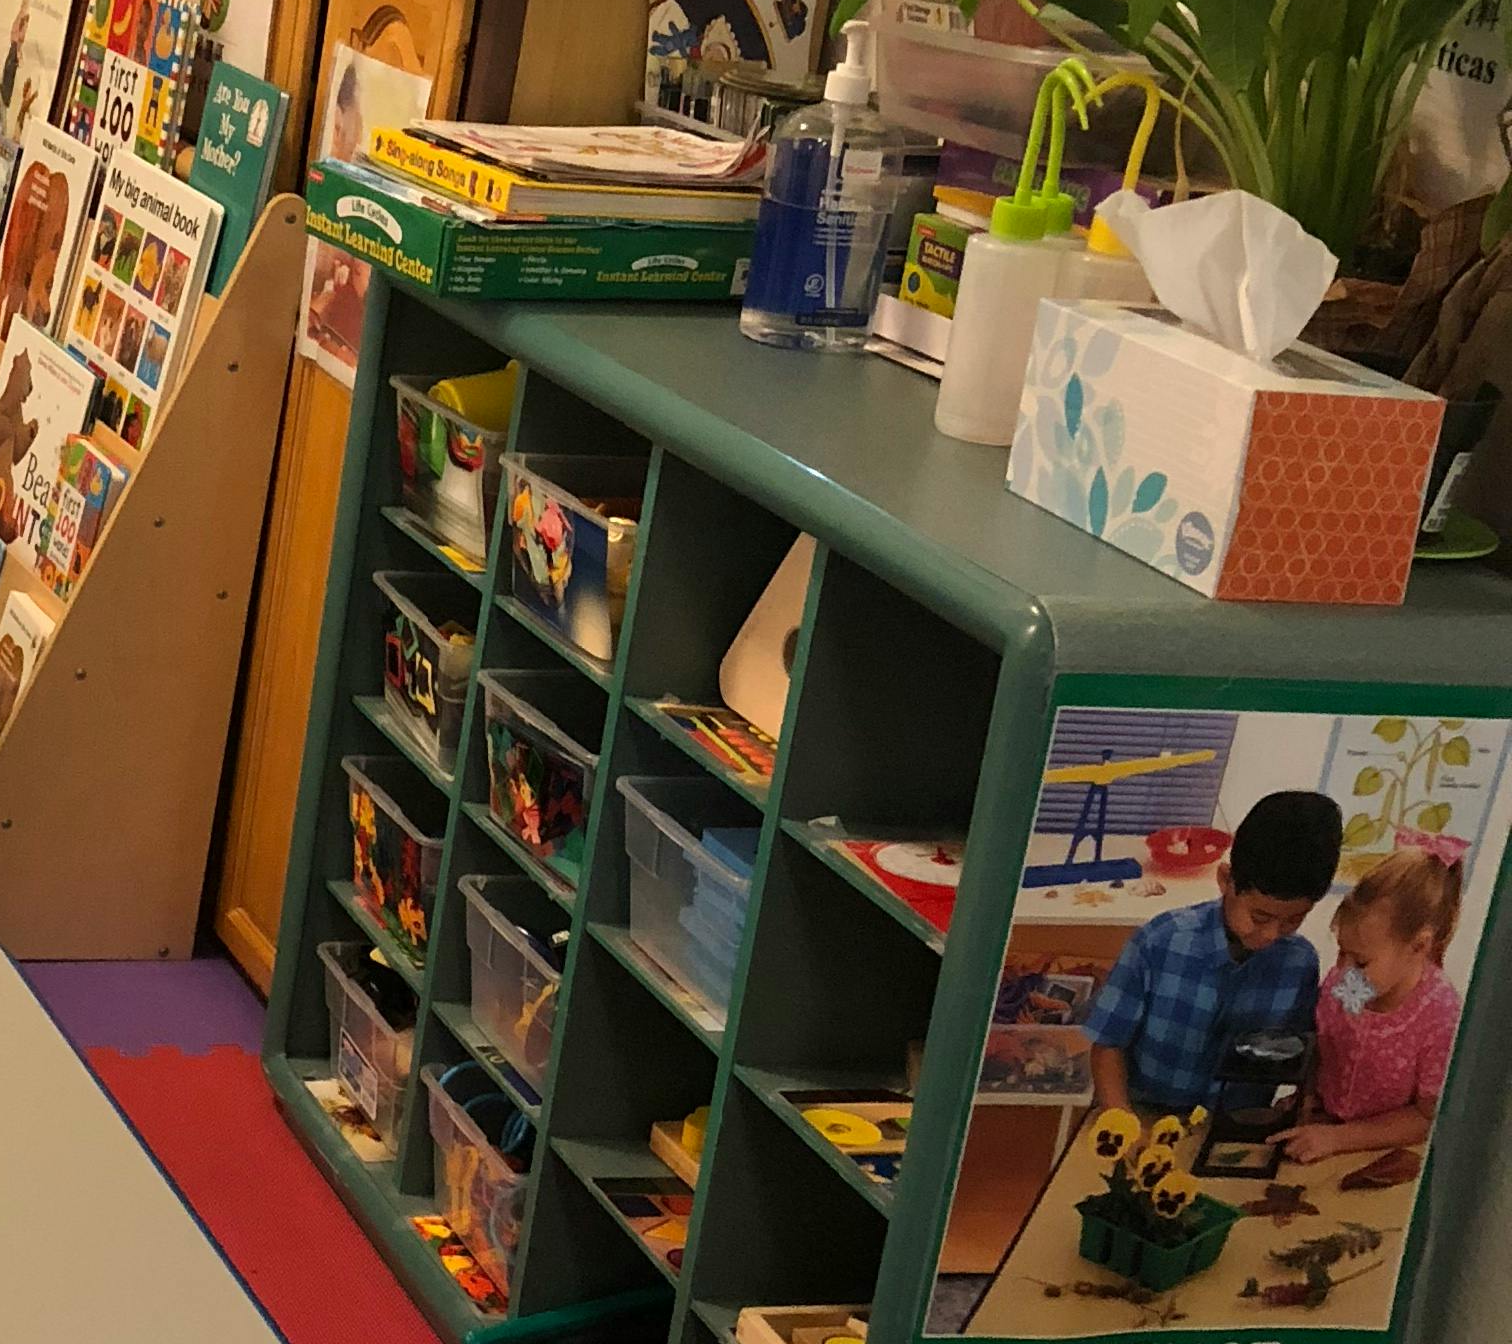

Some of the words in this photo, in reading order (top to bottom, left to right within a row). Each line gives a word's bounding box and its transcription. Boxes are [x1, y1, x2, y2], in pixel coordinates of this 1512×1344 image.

[109, 56, 139, 94] first
[99, 88, 134, 143] 100
[201, 137, 242, 177] Mother?
[109, 168, 124, 196] My
[125, 176, 140, 208] big
[139, 191, 172, 222] animal
[172, 208, 201, 240] book
[306, 205, 344, 241] Instant
[345, 223, 394, 267] Learning
[395, 249, 433, 284] Center
[923, 240, 956, 262] TACTILE
[691, 271, 728, 283] Center
[22, 452, 51, 508] Bea
[55, 515, 76, 544] 100
